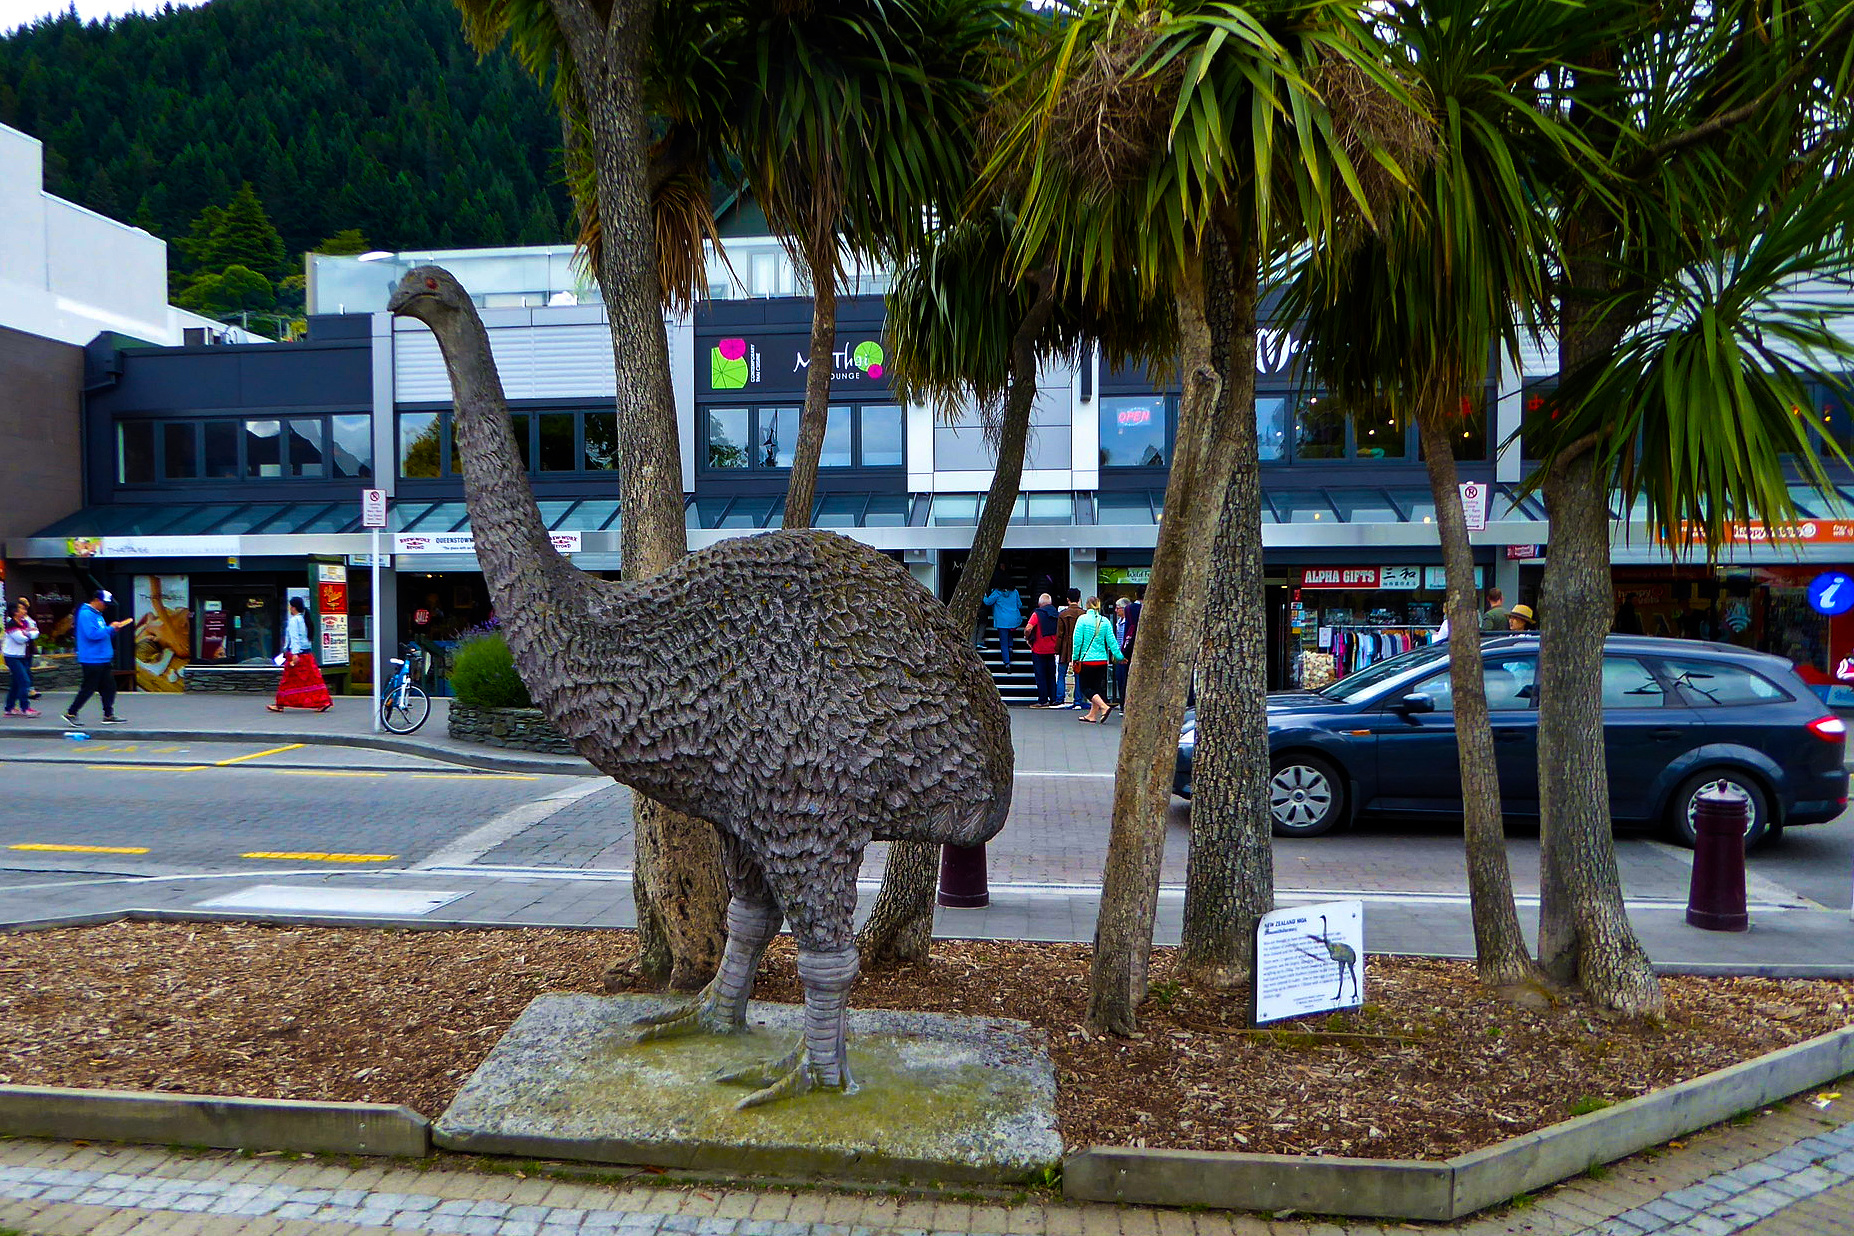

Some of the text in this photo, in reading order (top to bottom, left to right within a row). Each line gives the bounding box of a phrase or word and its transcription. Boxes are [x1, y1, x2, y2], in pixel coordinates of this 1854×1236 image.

[832, 341, 869, 370] Thai
[829, 372, 861, 380] OUNGE
[1118, 410, 1150, 424] OPEN
[1304, 570, 1375, 584] ALPHA GIFTS
[415, 611, 429, 623] SALE
[1275, 918, 1296, 928] ZEALAND
